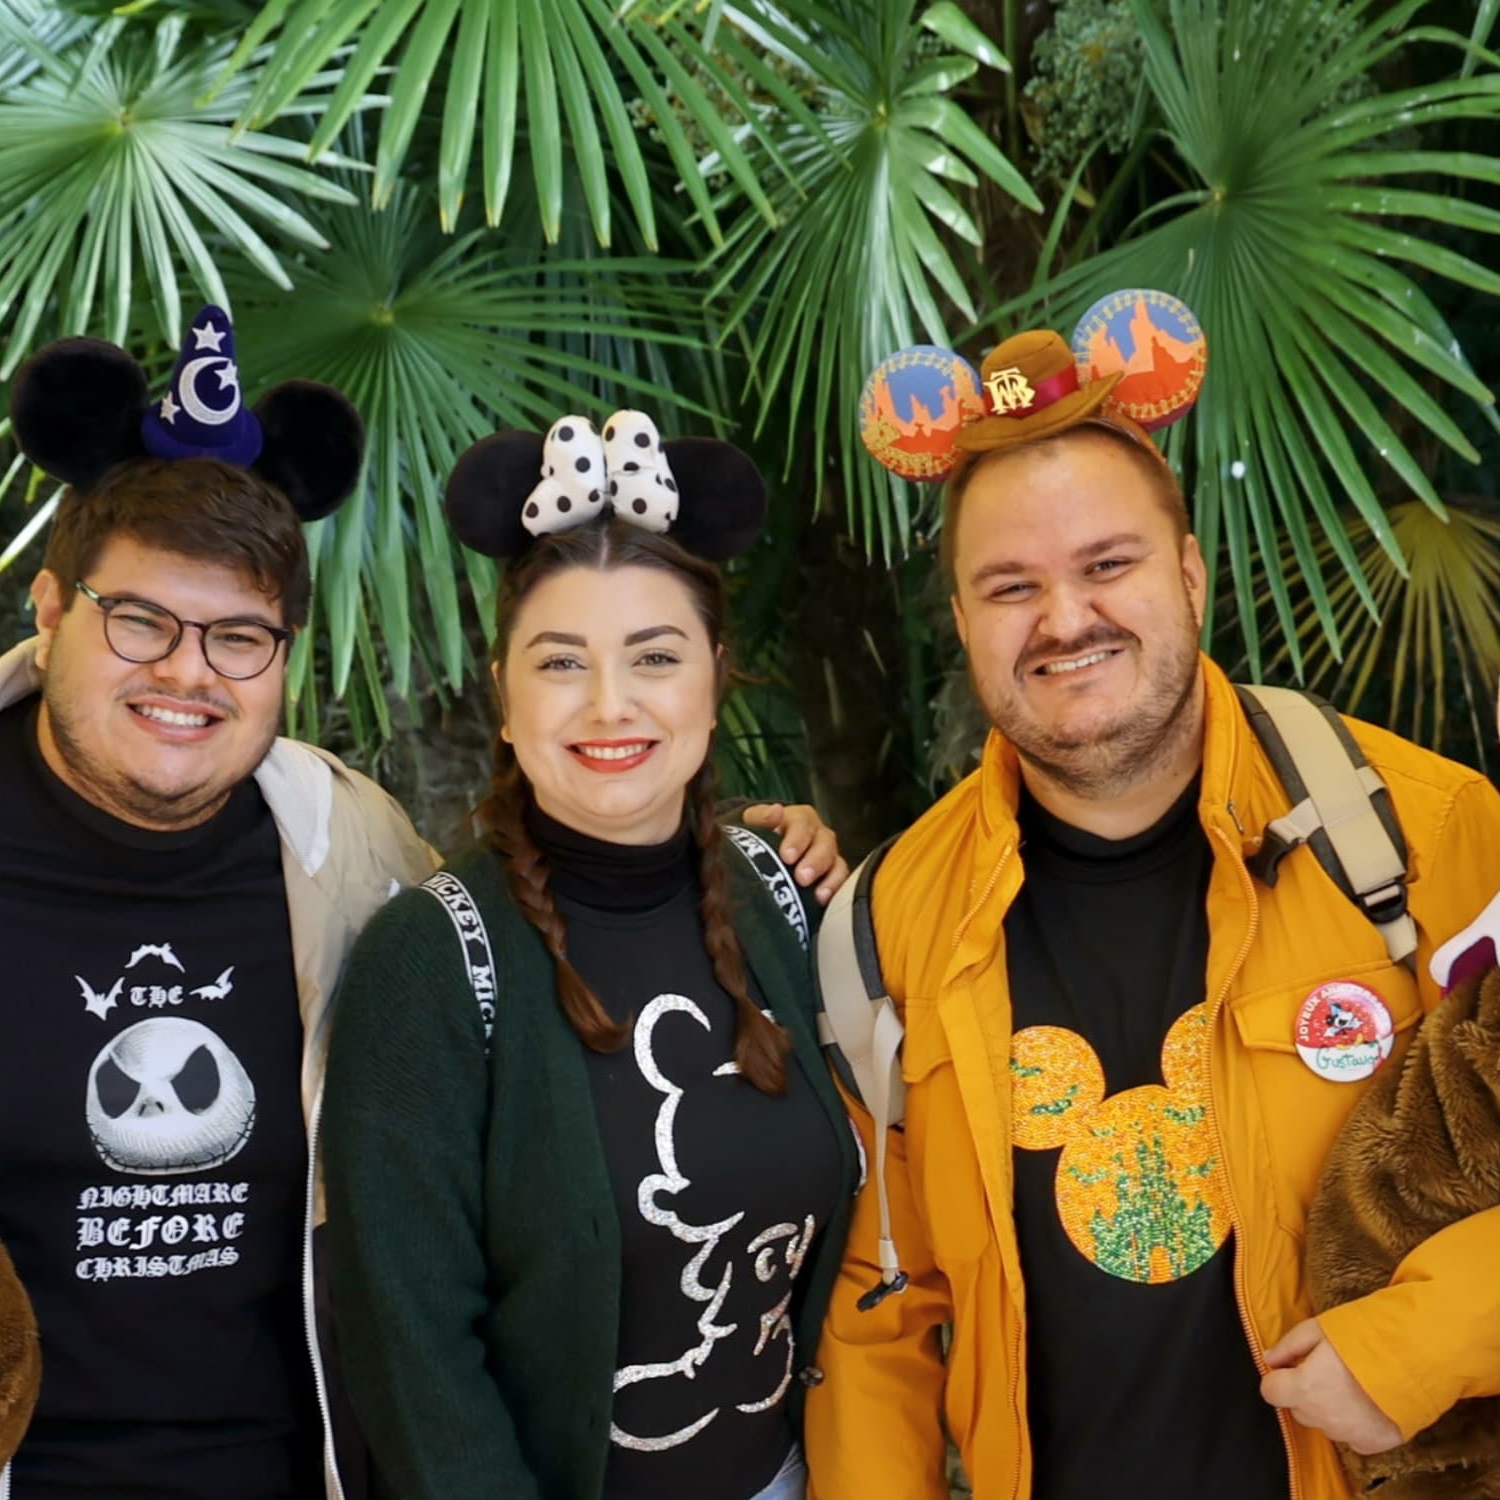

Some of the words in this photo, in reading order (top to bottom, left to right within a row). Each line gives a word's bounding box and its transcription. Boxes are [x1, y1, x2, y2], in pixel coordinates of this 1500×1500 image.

[129, 985, 184, 1008] THE
[1299, 995, 1321, 1042] JOYEUX
[76, 1182, 249, 1210] NIGHTMARE
[76, 1212, 245, 1251] BEFORE
[75, 1246, 240, 1282] CHRISTMAS
